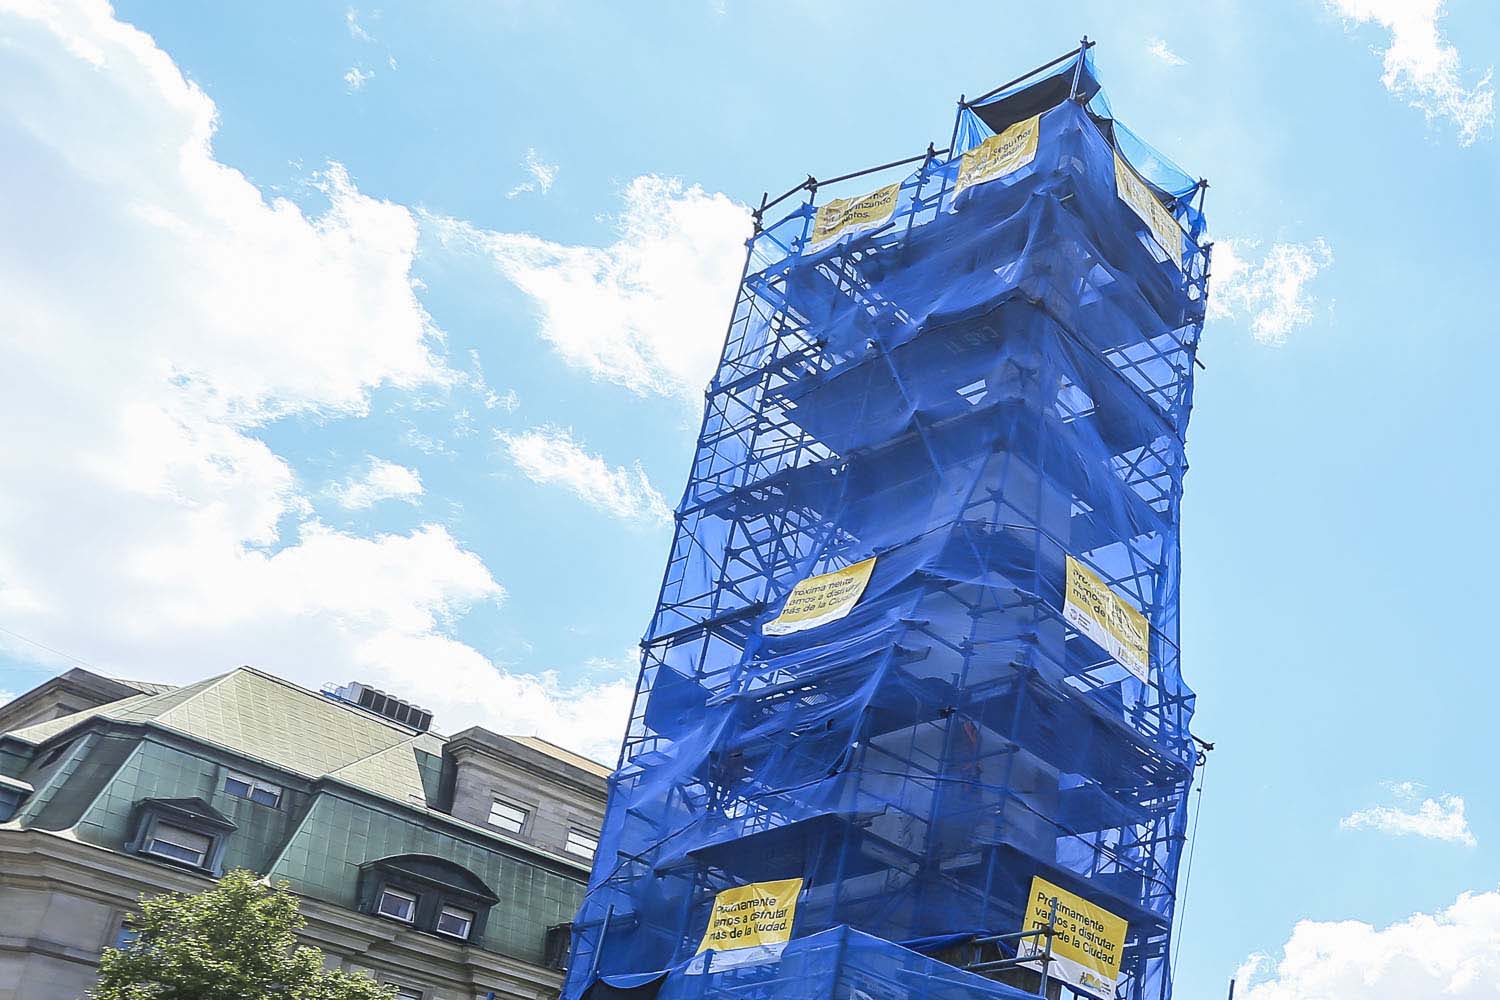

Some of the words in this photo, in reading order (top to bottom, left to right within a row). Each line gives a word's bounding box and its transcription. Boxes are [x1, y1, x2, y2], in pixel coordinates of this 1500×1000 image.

[730, 927, 742, 939] de
[744, 925, 752, 936] la
[1070, 923, 1076, 932] a
[1078, 926, 1115, 952] disfrutar
[1072, 935, 1080, 948] la
